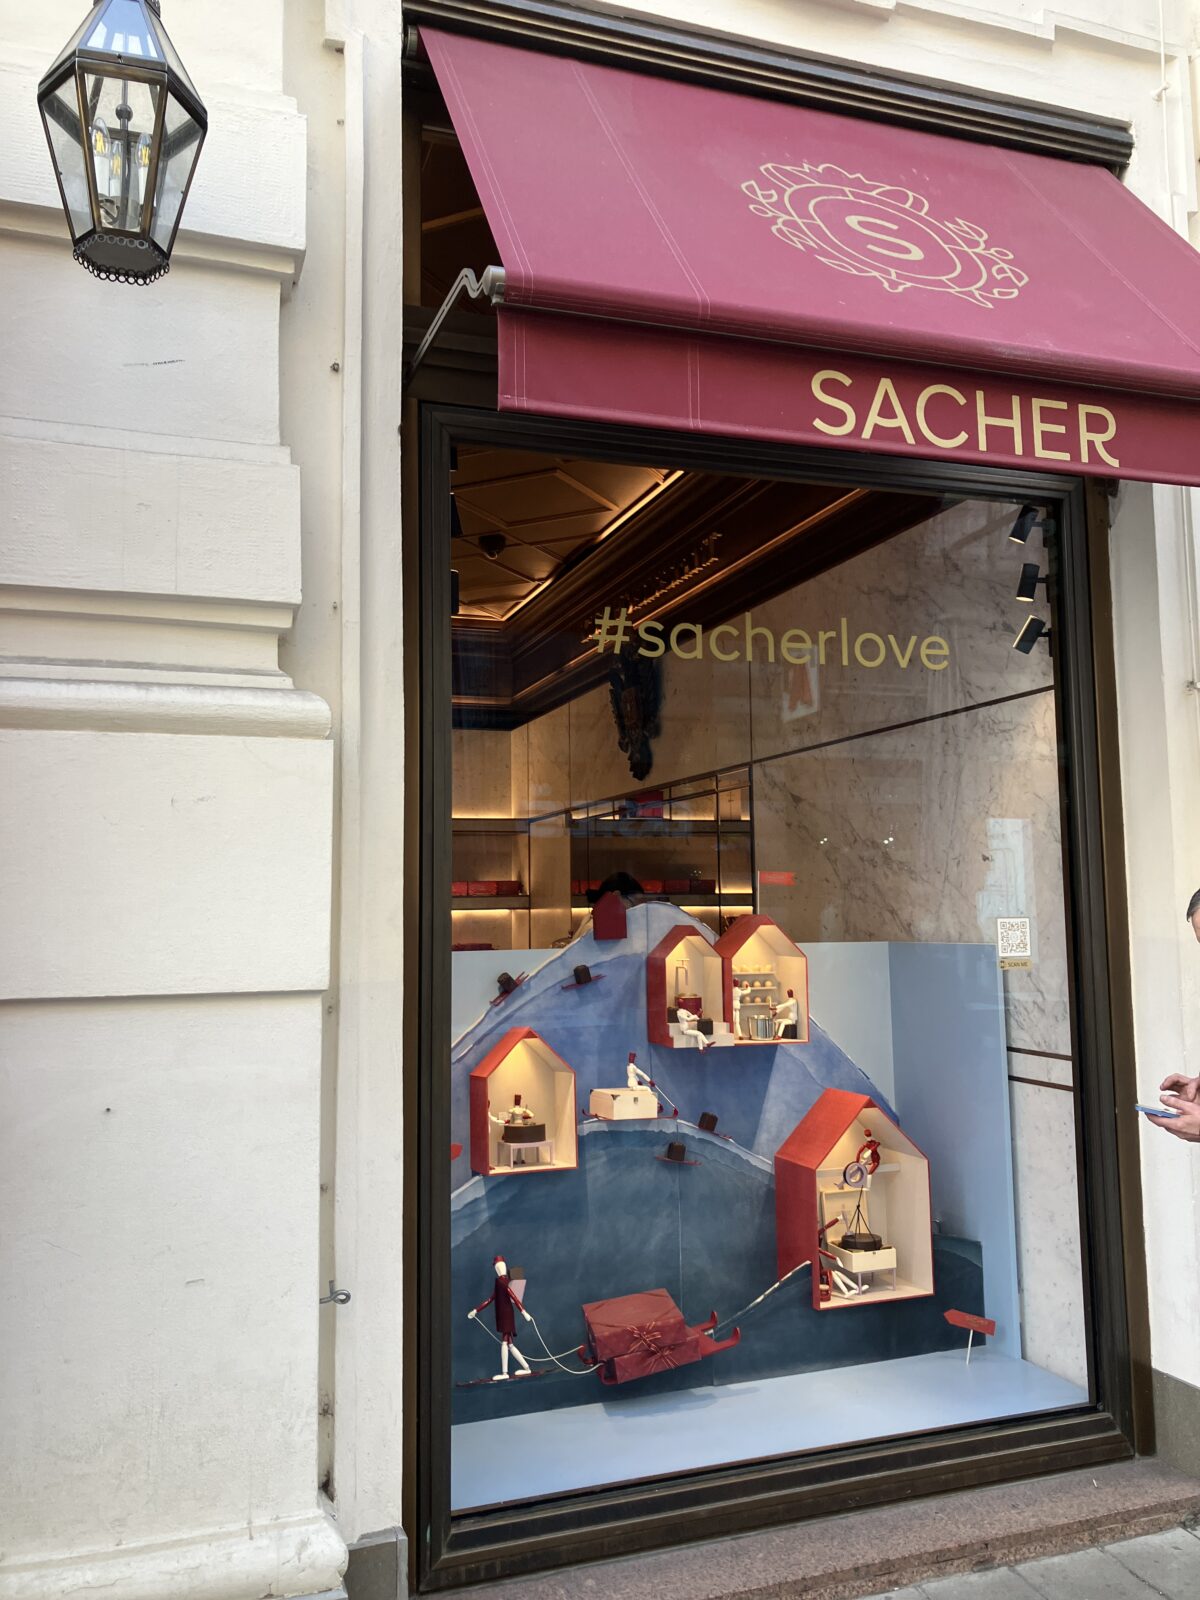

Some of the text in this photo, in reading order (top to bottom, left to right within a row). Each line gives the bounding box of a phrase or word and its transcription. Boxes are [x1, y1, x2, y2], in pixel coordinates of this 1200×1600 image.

[845, 215, 924, 261] S
[811, 369, 1119, 468] SACHER
[593, 606, 950, 671] #sacherlove
